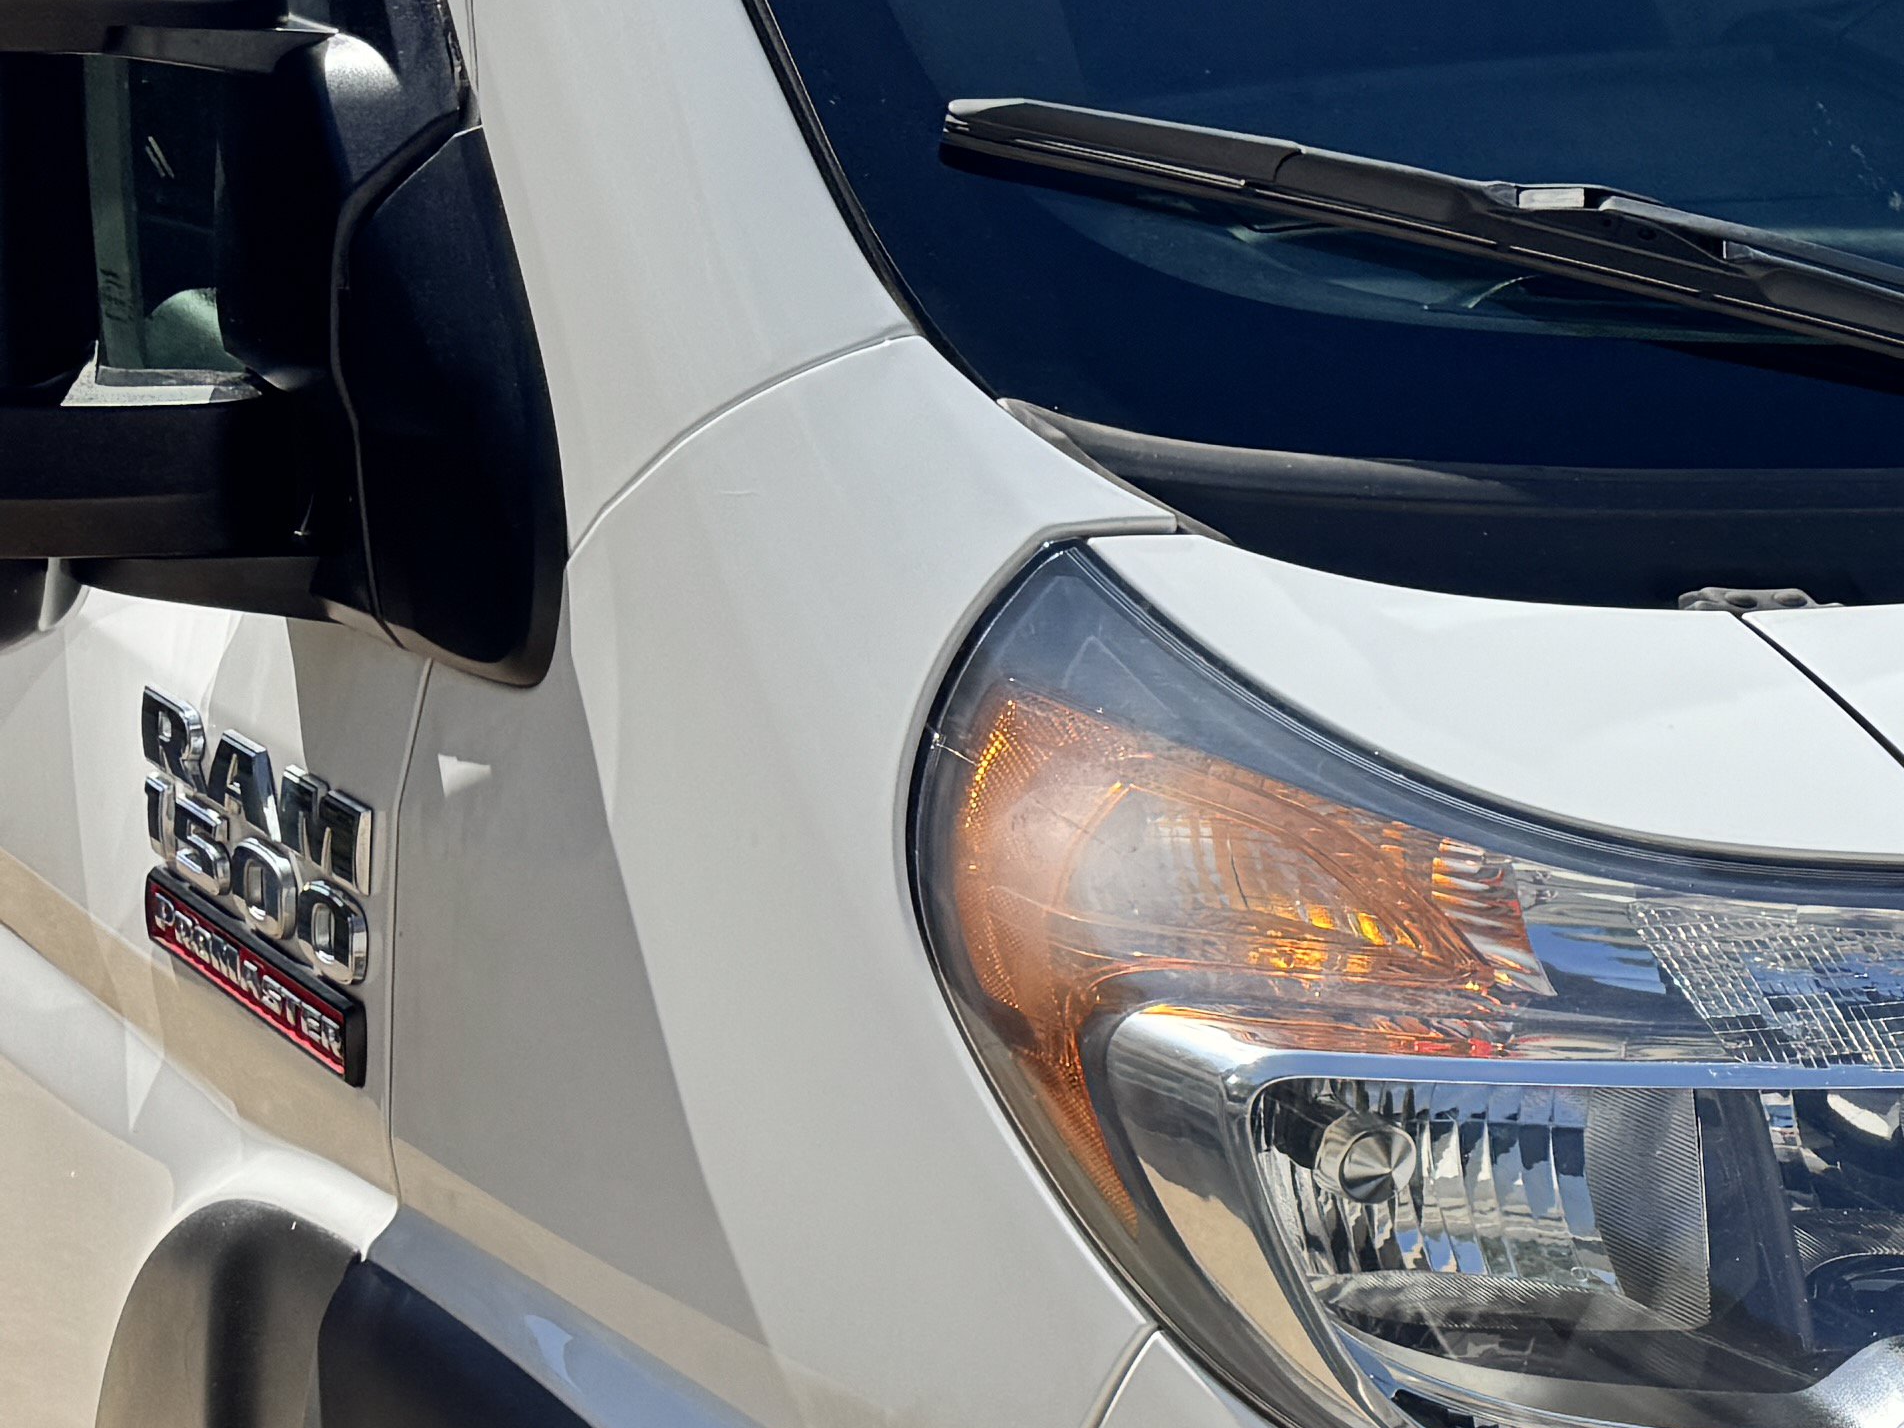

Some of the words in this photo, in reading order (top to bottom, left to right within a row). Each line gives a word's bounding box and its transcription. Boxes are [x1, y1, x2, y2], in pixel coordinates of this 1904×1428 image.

[141, 684, 374, 897] RAM
[144, 770, 369, 986] 1500
[154, 891, 345, 1060] PROMASTER
